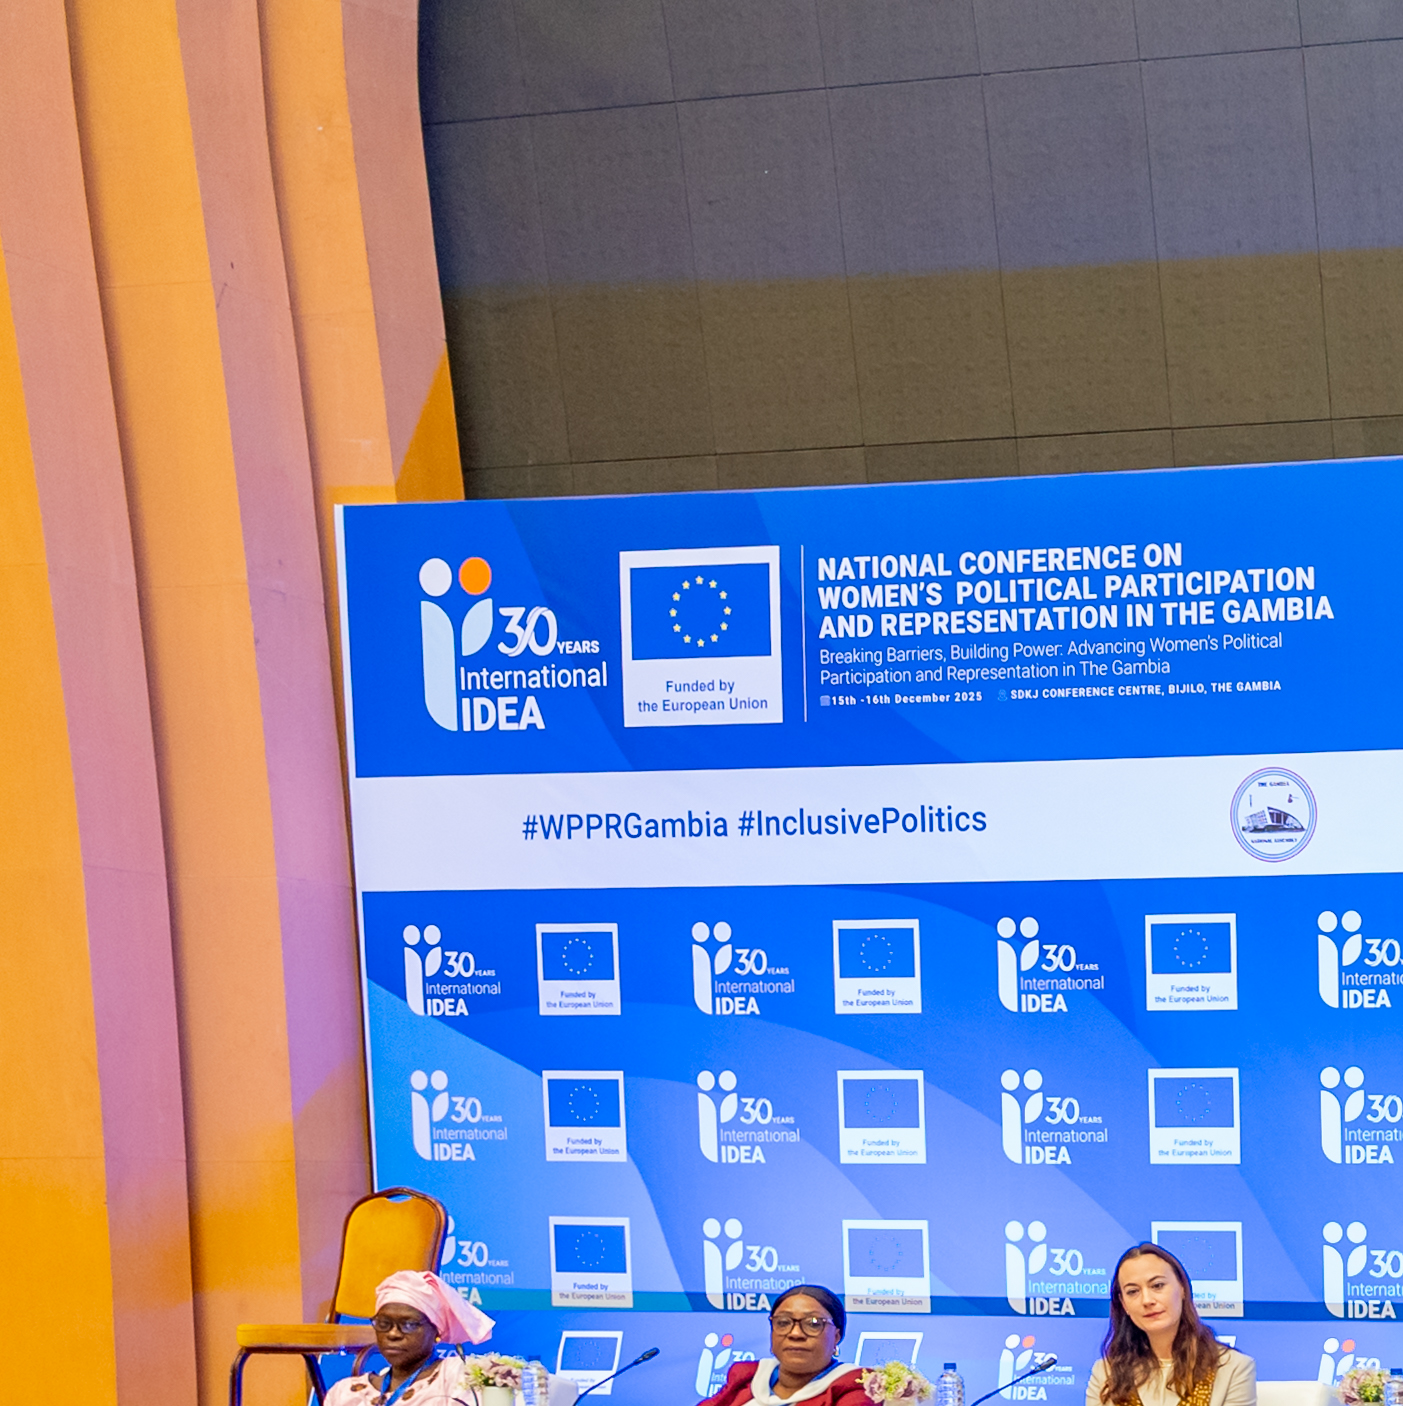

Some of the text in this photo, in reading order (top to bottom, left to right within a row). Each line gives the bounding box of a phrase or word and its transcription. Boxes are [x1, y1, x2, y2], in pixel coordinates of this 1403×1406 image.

[818, 542, 1182, 581] NATIONAL CONFERENCE ON
[957, 576, 1097, 605] POLITICAL
[1105, 566, 1315, 598] PARTICIPATION
[497, 606, 600, 657] 30 YEARS
[819, 596, 1334, 639] AND REPRESENTATION IN THE GAMBIA
[820, 648, 882, 666] Breaking
[887, 646, 946, 662] Barriers,
[951, 643, 1008, 662] Building
[1013, 642, 1063, 657] Power:
[1067, 638, 1145, 657] Advancing
[1223, 632, 1282, 650] Political
[460, 661, 607, 690] International
[666, 679, 735, 694] Funded by
[821, 658, 1170, 687] Participation and Representation in The Gambia
[832, 691, 982, 705] 15th -16th December 2025
[1011, 680, 1281, 699] SDKJ CONFERENCE CENTRE, BIJILO, THE GAMBIA
[462, 696, 545, 732] IDEA
[638, 697, 768, 713] the European Union
[522, 805, 987, 840] #WPPRGambia #InclusivePolitics
[1363, 938, 1401, 967] 30
[1342, 989, 1392, 1009] IDEA
